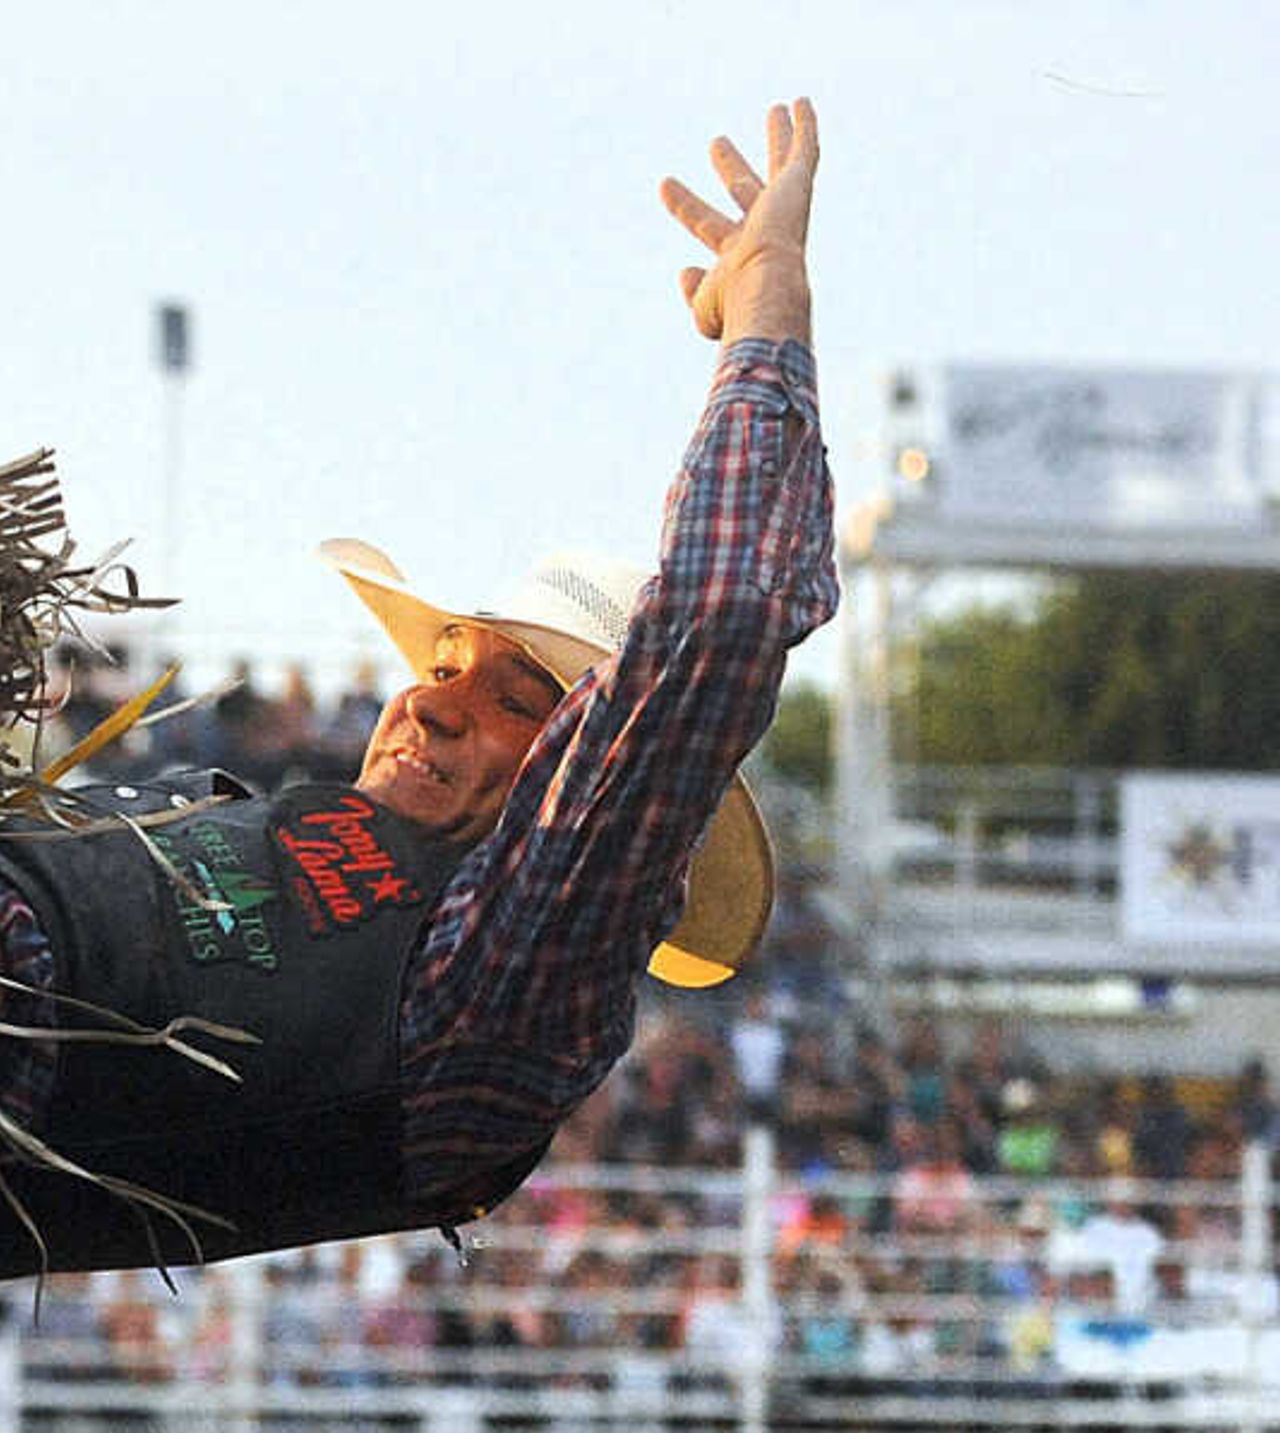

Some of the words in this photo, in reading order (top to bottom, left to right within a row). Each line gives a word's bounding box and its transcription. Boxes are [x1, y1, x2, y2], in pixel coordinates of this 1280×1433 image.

[301, 796, 395, 872] Tony
[278, 826, 362, 923] Lama
[239, 916, 277, 970] TOP
